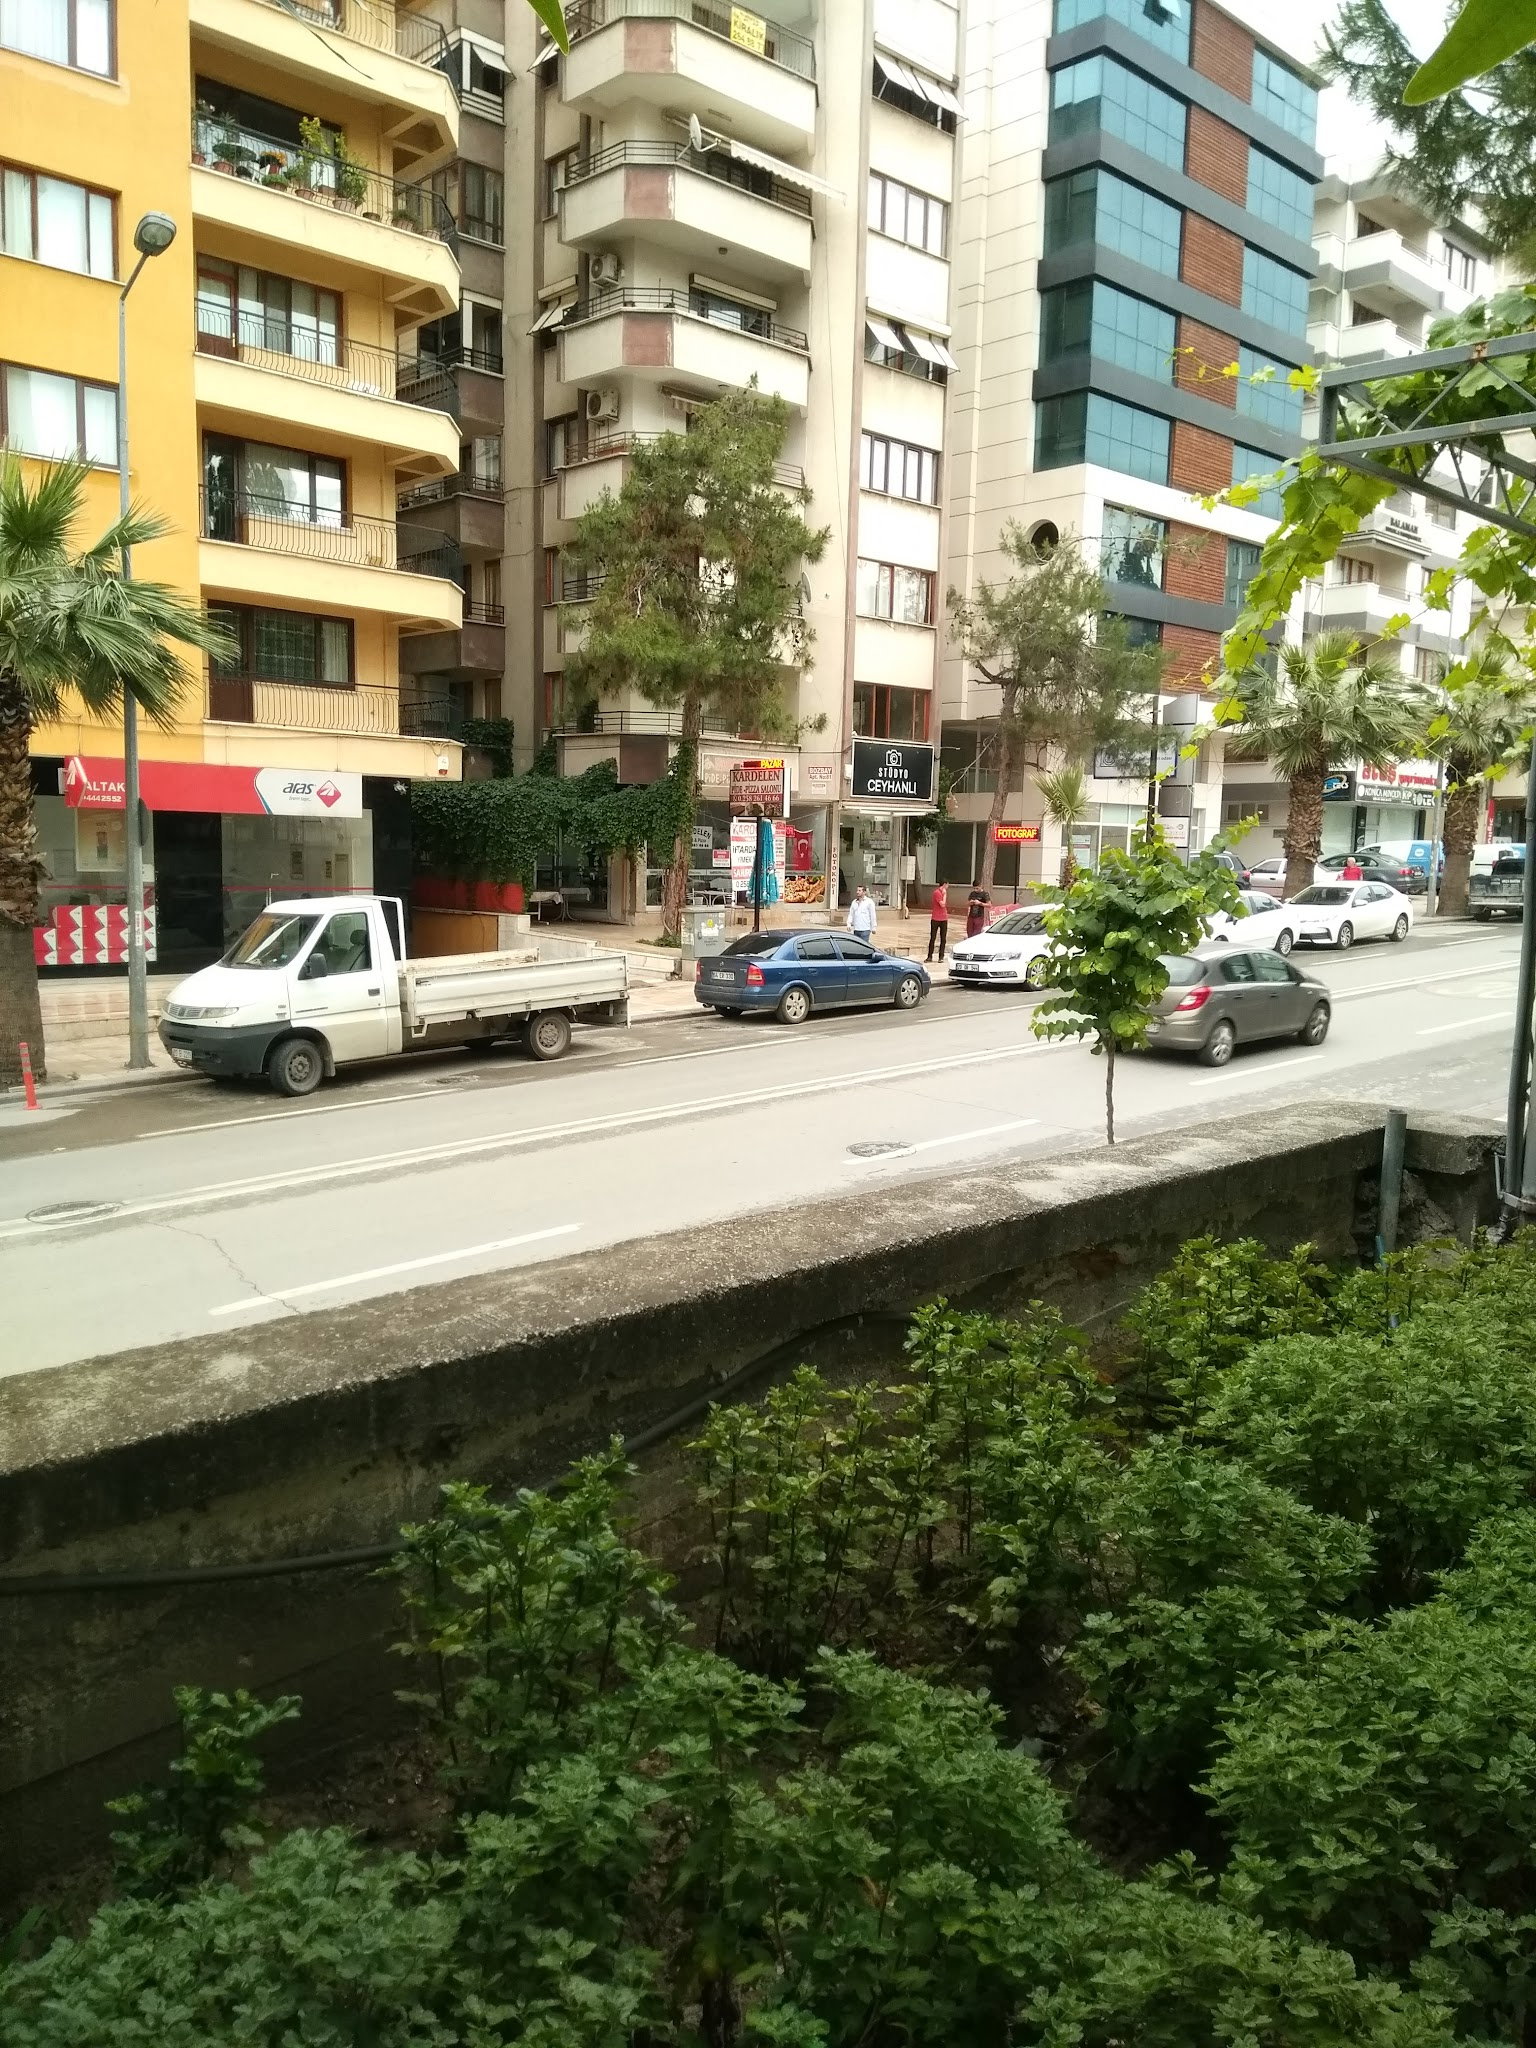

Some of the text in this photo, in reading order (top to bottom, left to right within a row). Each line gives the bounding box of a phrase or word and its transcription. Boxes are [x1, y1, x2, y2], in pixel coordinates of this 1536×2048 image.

[760, 759, 783, 769] PAZAR
[732, 770, 780, 782] KARDELEN
[878, 766, 909, 779] STÜDYO
[282, 782, 314, 795] aras
[760, 784, 782, 794] SALONU
[867, 779, 917, 795] CEYHANLI
[997, 829, 1038, 839] FOTOGRAF
